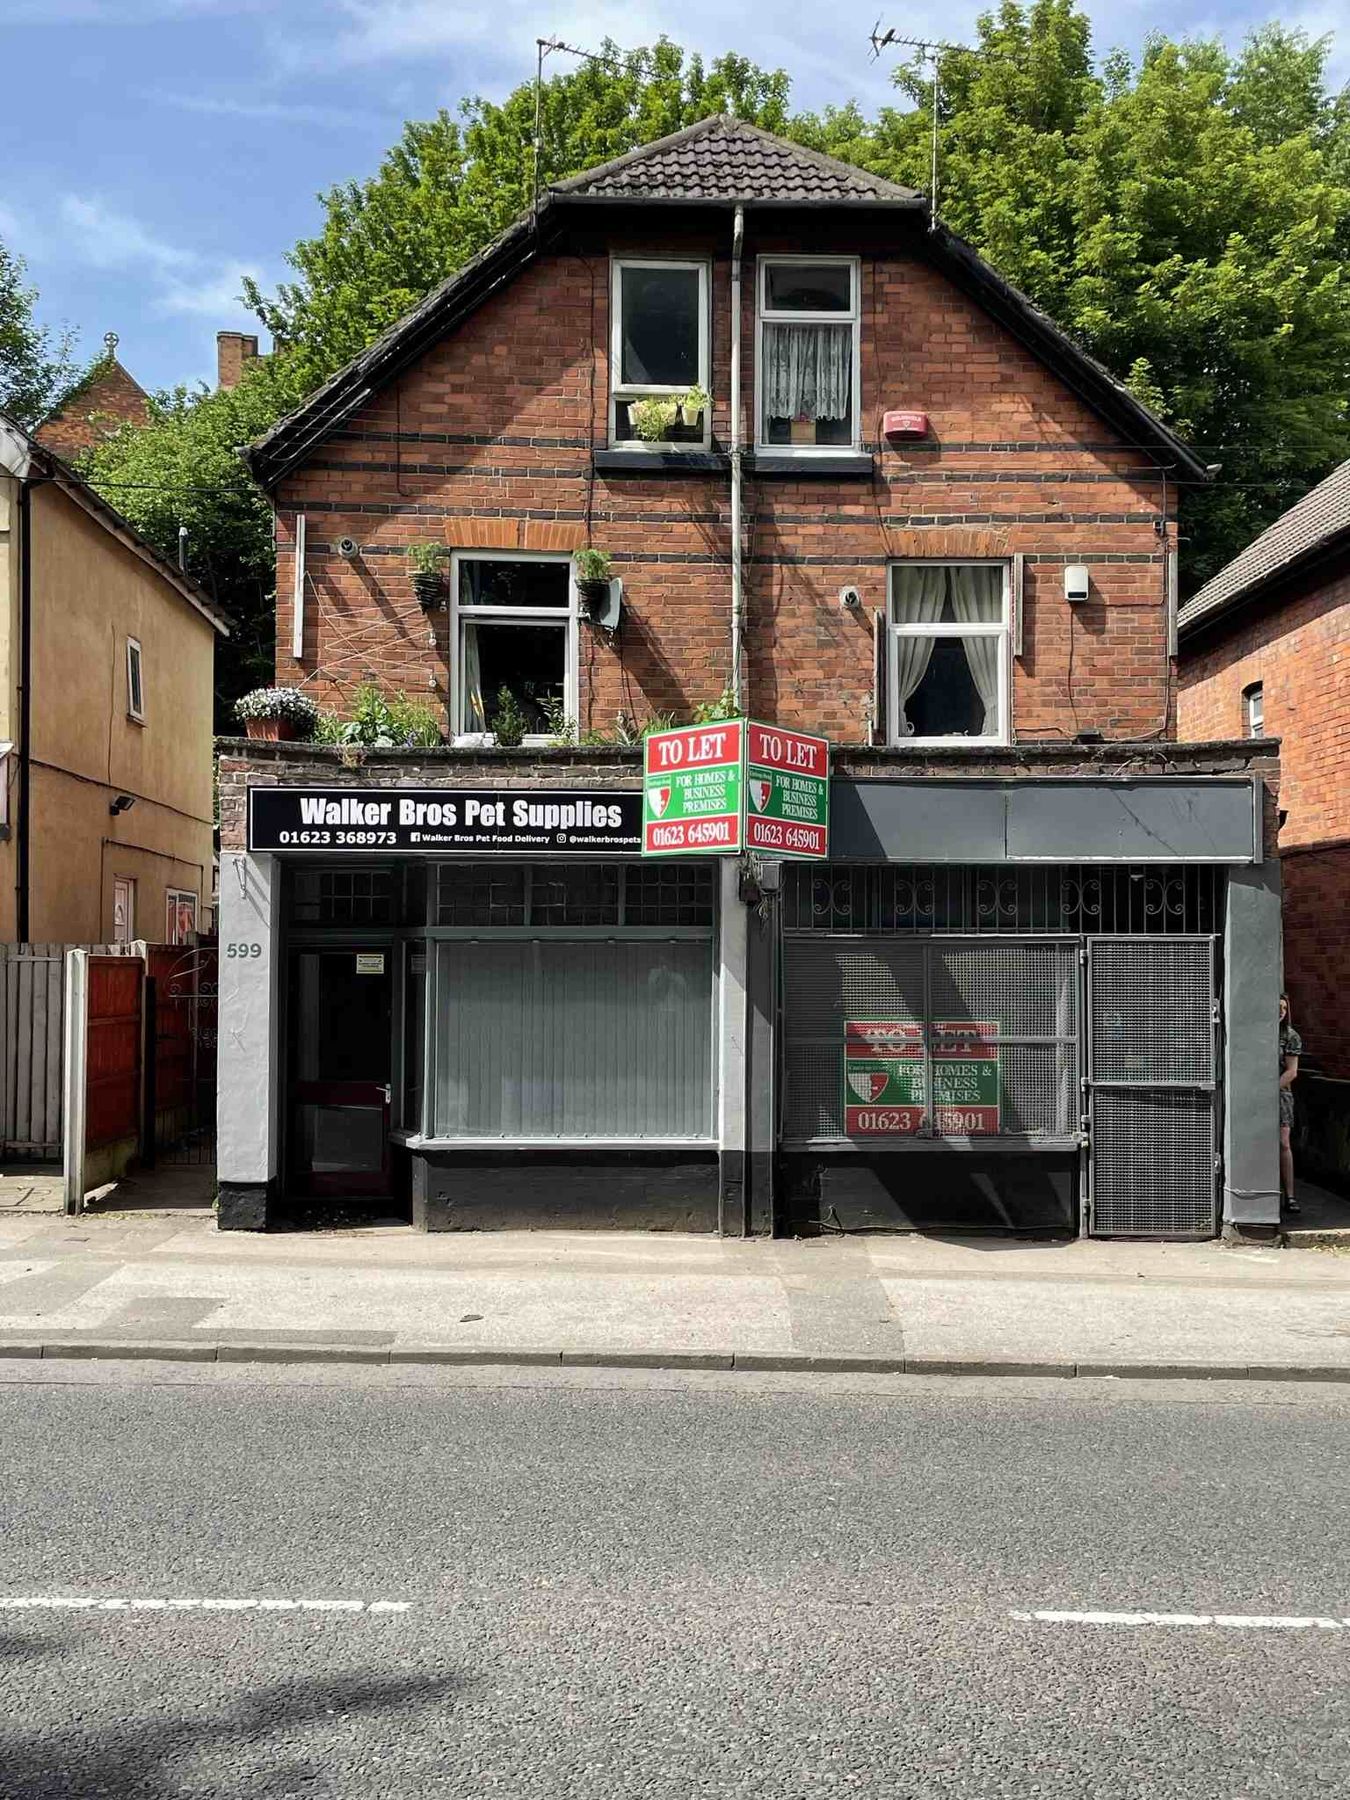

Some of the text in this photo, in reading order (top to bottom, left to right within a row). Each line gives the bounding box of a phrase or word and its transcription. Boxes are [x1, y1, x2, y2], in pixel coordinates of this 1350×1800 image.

[658, 733, 726, 765] TO LET
[760, 733, 818, 769] TO LET
[676, 774, 693, 788] FOR
[694, 770, 727, 786] HOMES
[728, 770, 736, 782] &
[775, 775, 791, 789] FOR
[791, 778, 817, 794] HOMES
[818, 783, 824, 796] &
[683, 784, 726, 800] BUSINESS
[782, 789, 817, 807] BUSINESS
[300, 798, 622, 830] Walker Bros Pet Supplies
[682, 799, 727, 814] PREMISES
[781, 804, 818, 821] PREMISES
[279, 831, 397, 845] 01623 368973
[422, 833, 550, 844] Walker Bros Pet Food Delivery
[652, 821, 730, 847] 01623 645901
[754, 822, 820, 850] 01623 645901
[227, 943, 262, 958] 599
[917, 1029, 978, 1052] ET
[982, 1065, 992, 1076] &
[911, 1077, 978, 1089] BINESS
[858, 1112, 912, 1130] 01623
